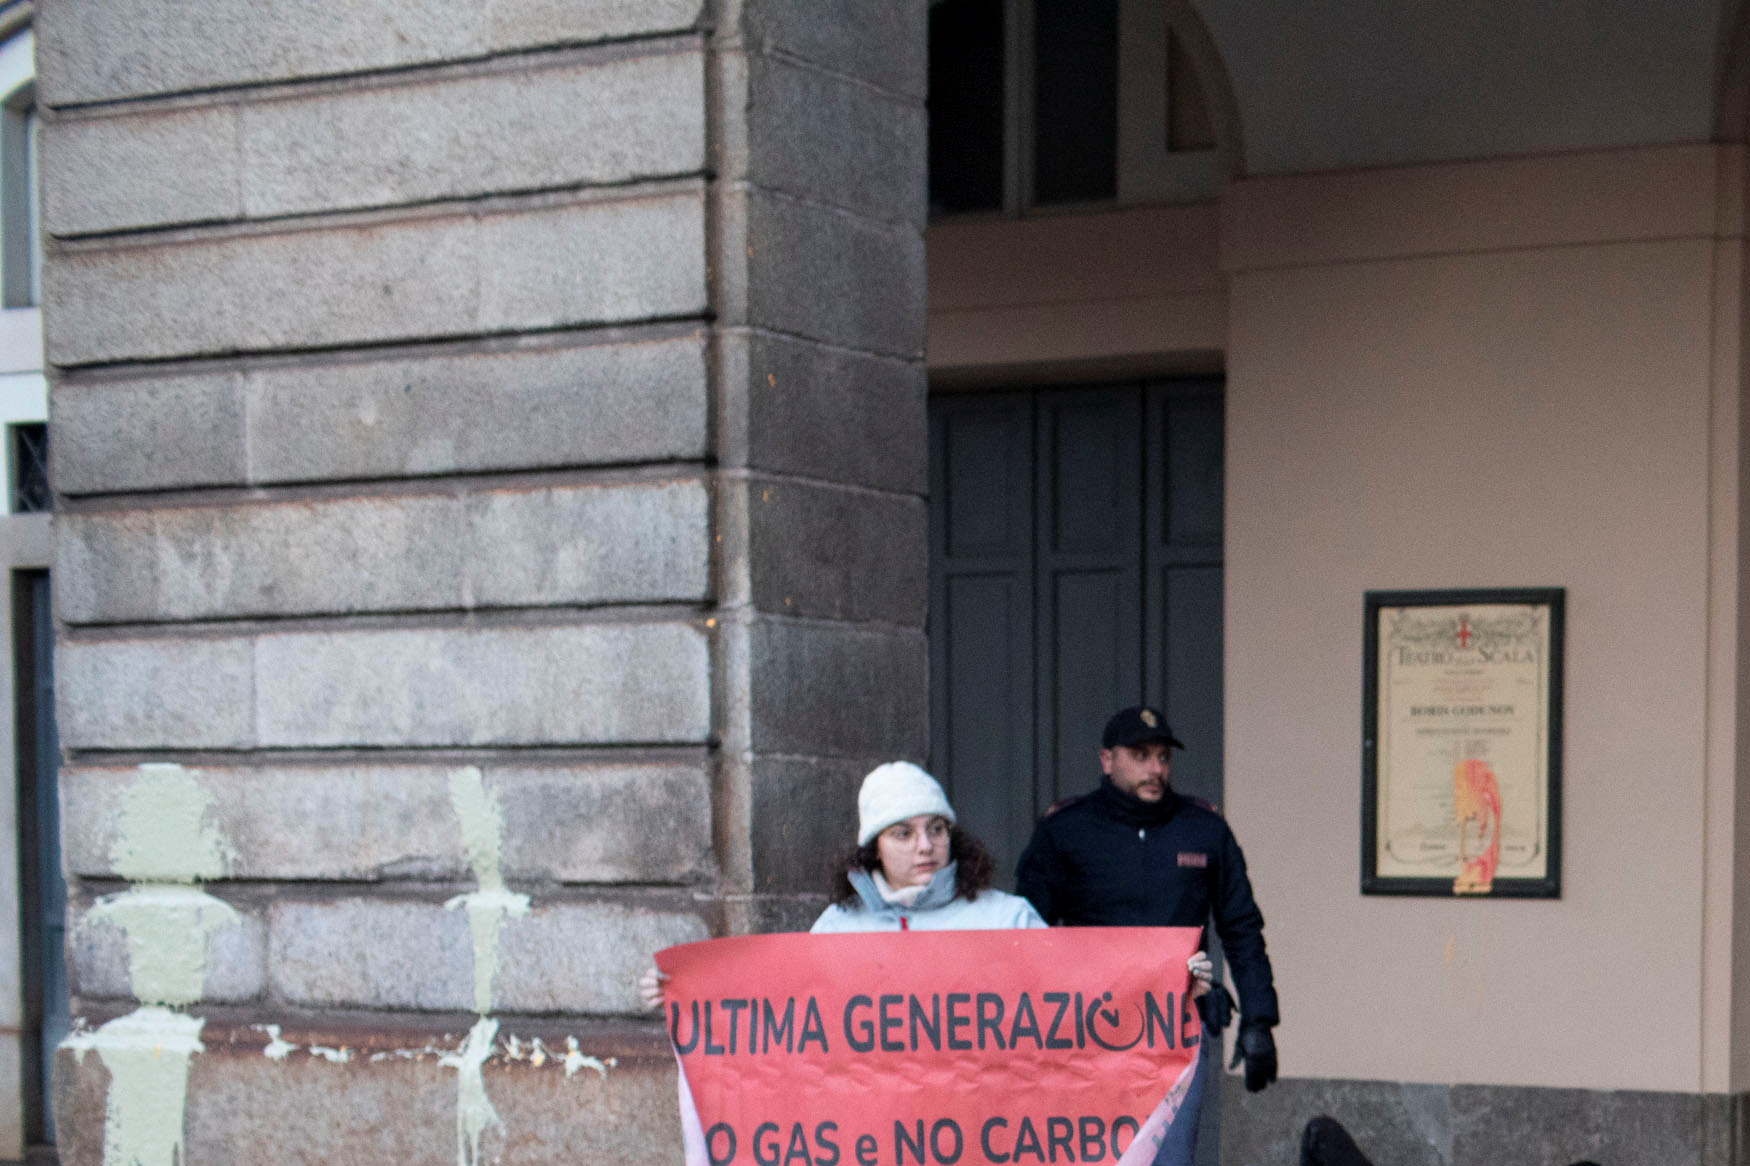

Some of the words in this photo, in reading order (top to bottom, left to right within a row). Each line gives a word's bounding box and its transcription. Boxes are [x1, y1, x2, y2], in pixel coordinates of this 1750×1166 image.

[671, 996, 829, 1055] ULTIMA
[855, 1132, 878, 1166] e
[894, 1118, 964, 1166] NO
[981, 1115, 1149, 1164] CARBO
